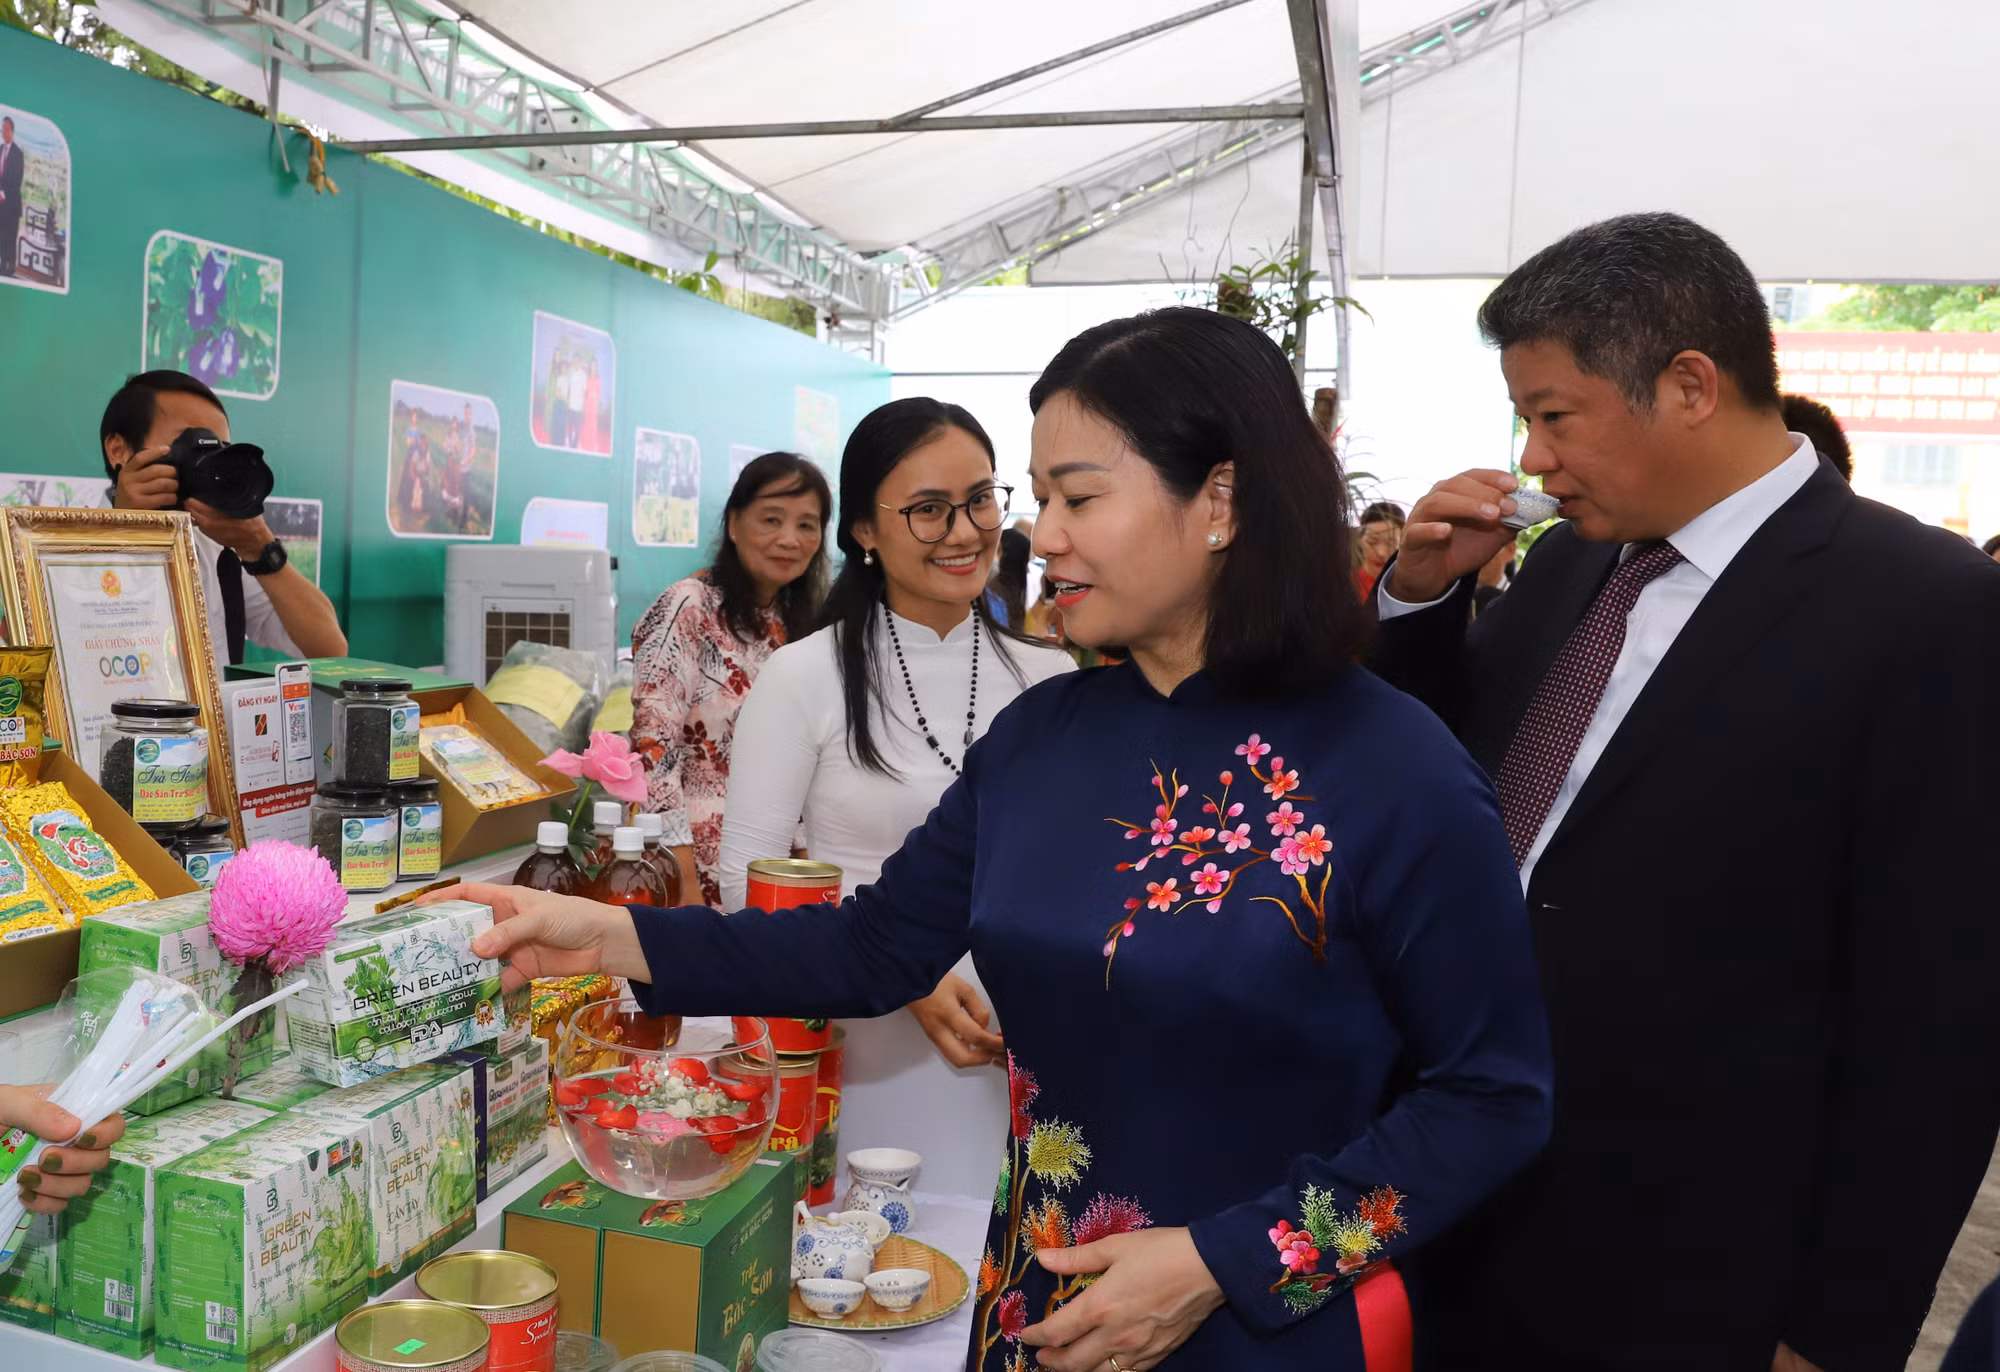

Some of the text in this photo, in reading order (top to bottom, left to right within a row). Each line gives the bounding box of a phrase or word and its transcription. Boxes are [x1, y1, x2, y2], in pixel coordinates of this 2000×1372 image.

[99, 652, 152, 678] OCOP
[0, 718, 23, 731] COP
[138, 765, 167, 784] Trà
[354, 961, 482, 1010] GREEN BEAUTY
[410, 1020, 442, 1044] FDA
[389, 1143, 431, 1174] GREEN
[387, 1160, 432, 1194] BEAUTY
[265, 1207, 312, 1243] GREEN
[260, 1225, 314, 1267] BEAUTY
